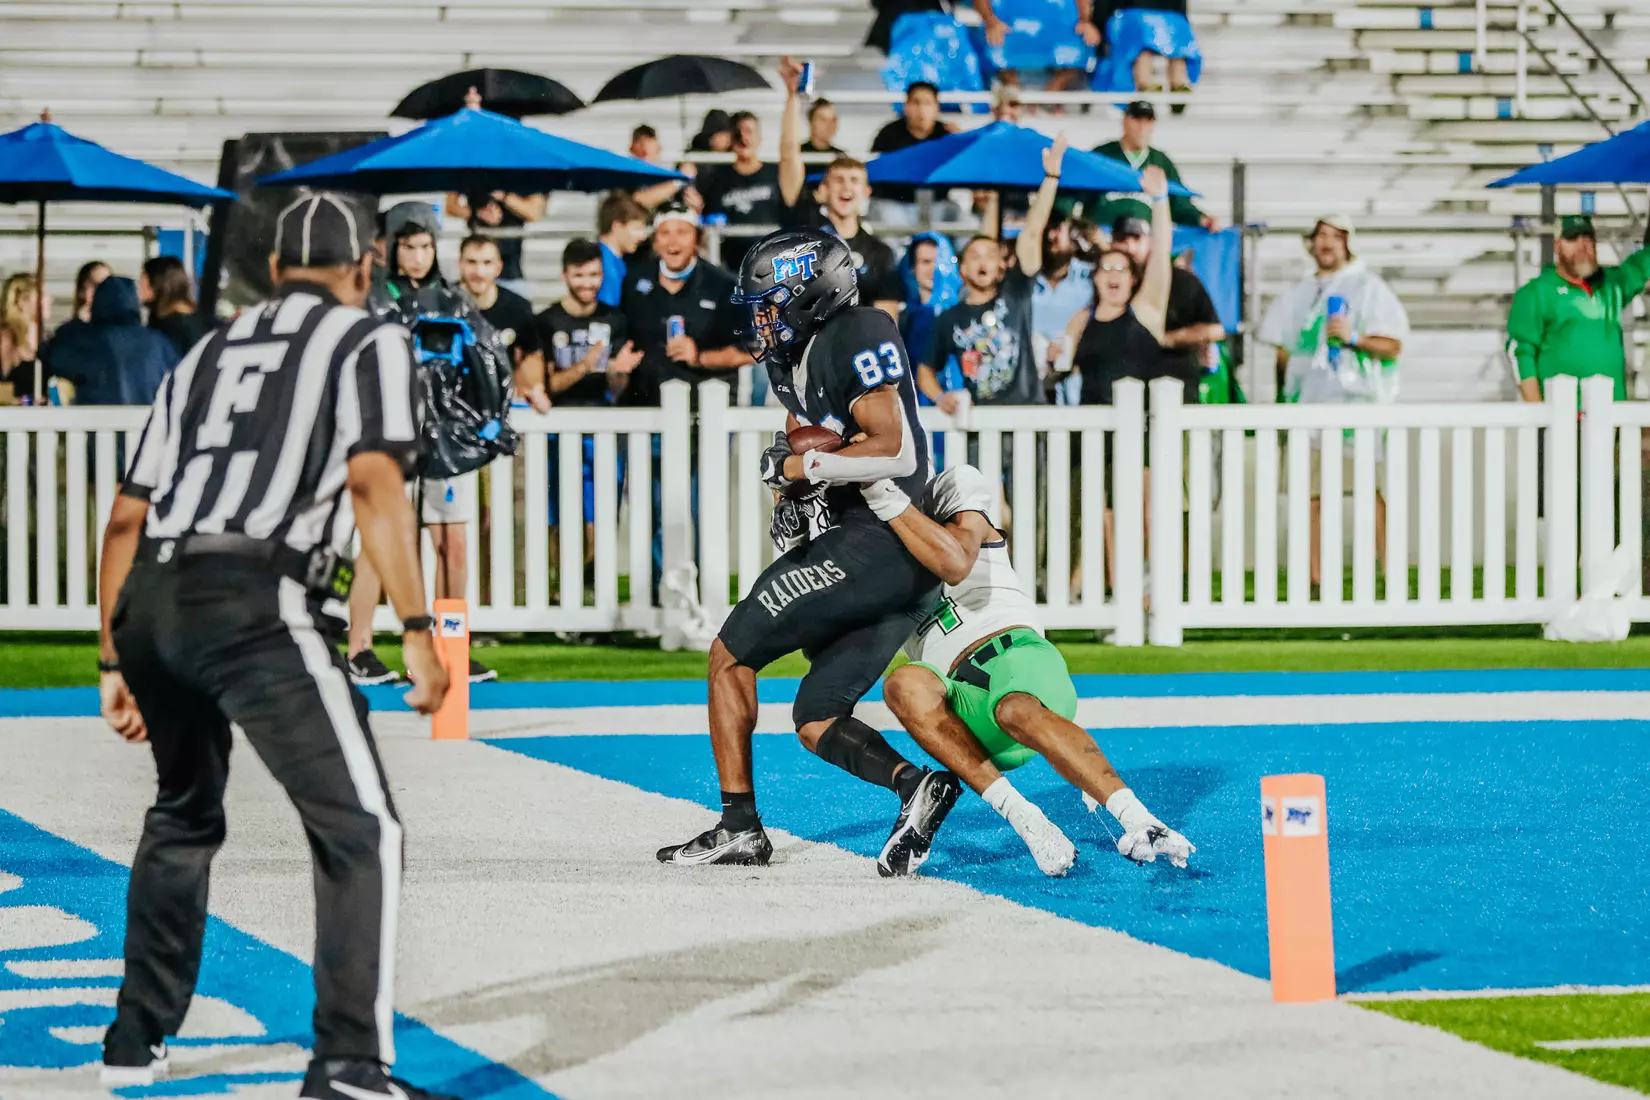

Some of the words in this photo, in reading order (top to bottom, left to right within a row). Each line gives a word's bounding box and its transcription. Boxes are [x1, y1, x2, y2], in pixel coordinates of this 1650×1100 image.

[772, 251, 817, 284] MT
[852, 341, 904, 388] 83
[196, 340, 289, 450] F
[757, 559, 847, 618] RAIDERS
